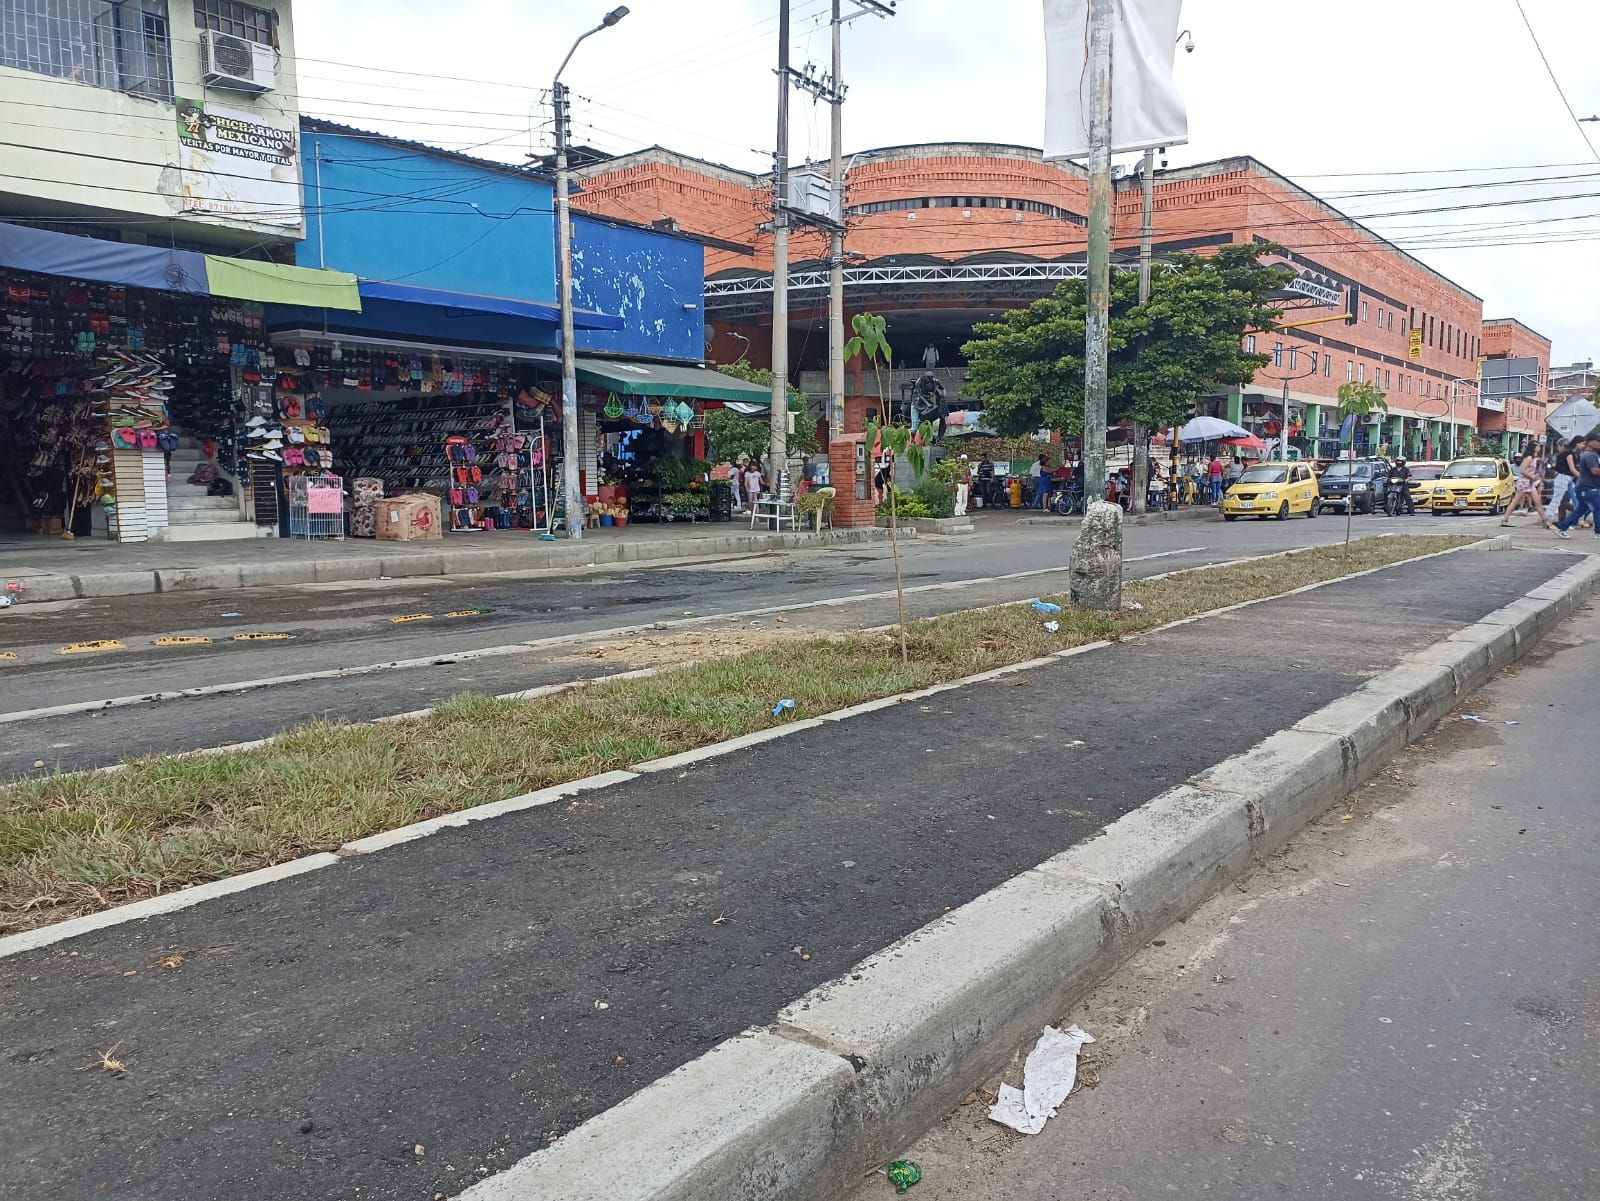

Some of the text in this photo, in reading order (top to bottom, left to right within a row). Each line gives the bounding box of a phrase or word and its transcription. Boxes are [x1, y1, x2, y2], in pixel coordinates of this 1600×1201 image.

[208, 115, 292, 141] CHICHARRON
[217, 127, 283, 150] MEXICANO
[181, 137, 292, 166] VENTAS POR MAYOR Y DETAL
